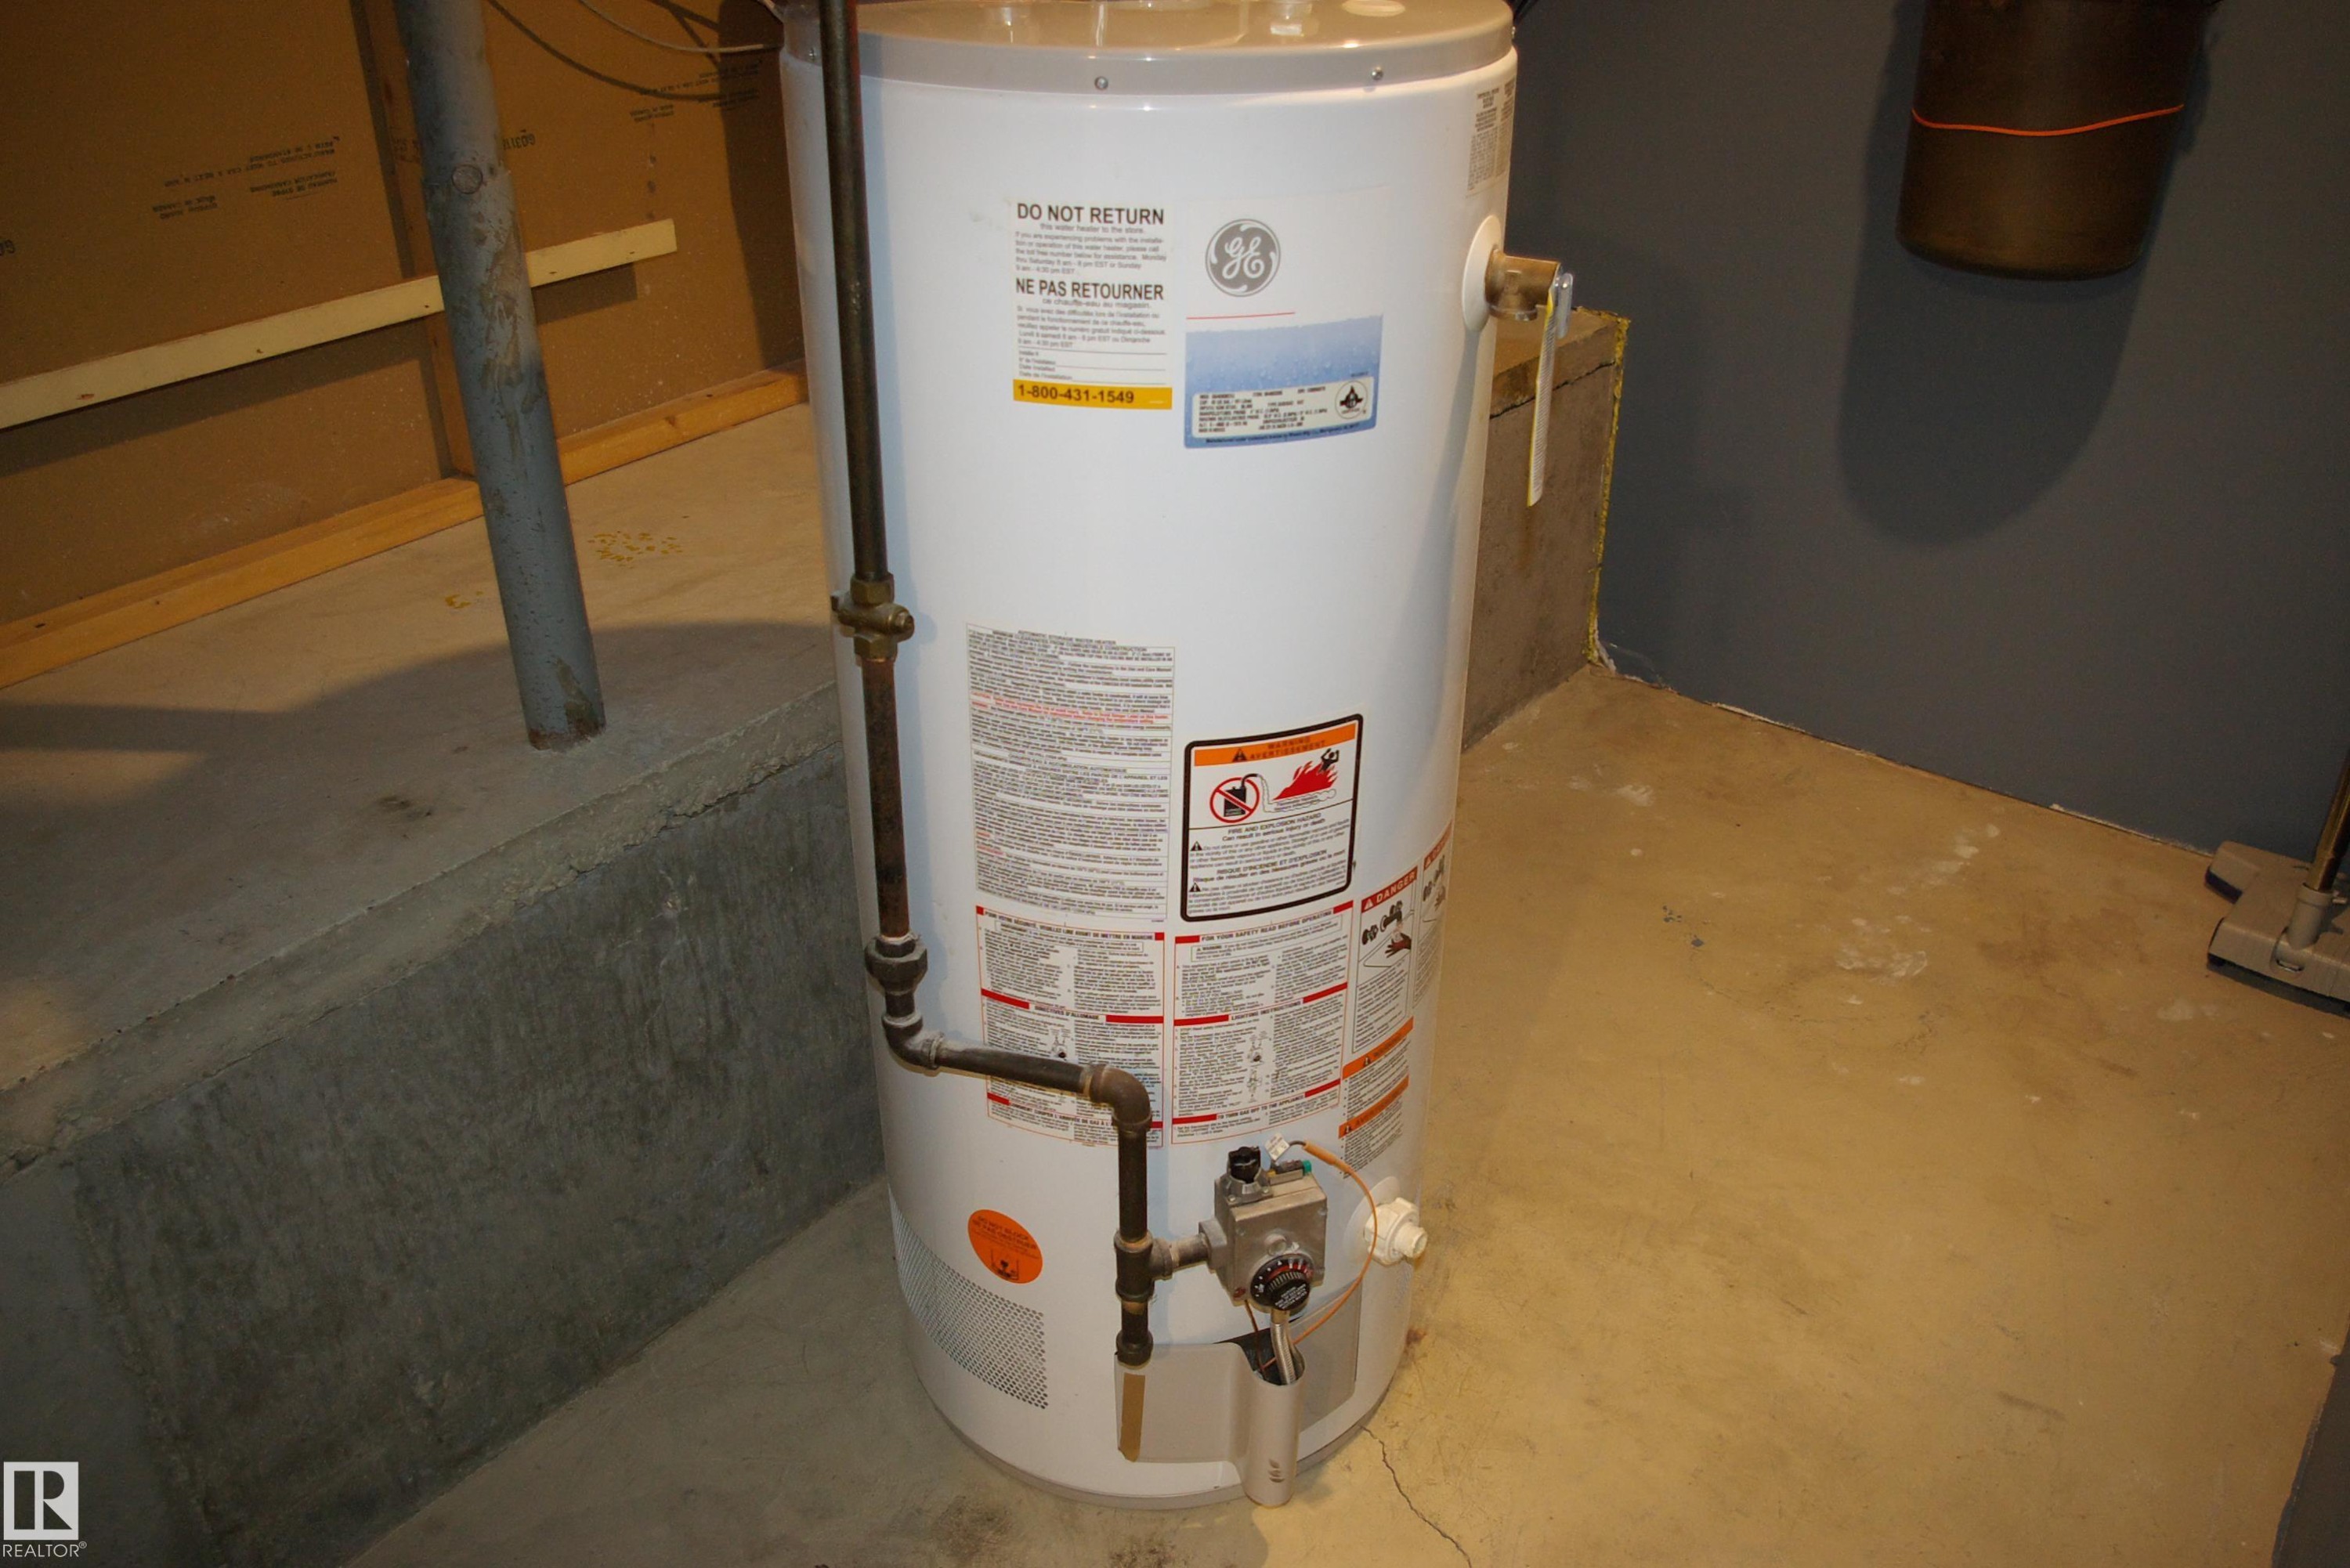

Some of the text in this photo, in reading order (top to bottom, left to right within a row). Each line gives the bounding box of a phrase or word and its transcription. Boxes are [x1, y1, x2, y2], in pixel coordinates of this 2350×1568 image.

[1018, 203, 1164, 225] DO NOT RETURN
[1077, 224, 1100, 233] heater
[1016, 278, 1164, 300] NE PAS RETOURNER
[1054, 298, 1101, 308] chauffe-eau
[1018, 384, 1134, 403] 1-800-431-1549
[1267, 736, 1311, 750] WARNING
[1260, 819, 1295, 830] EXPLOSION
[1297, 812, 1321, 822] HAZARD
[1285, 824, 1301, 833] injury
[1376, 871, 1415, 903] DANGER
[1235, 930, 1259, 938] SAFETY
[1278, 920, 1300, 930] BEFORE
[1301, 911, 1332, 924] OPERATING
